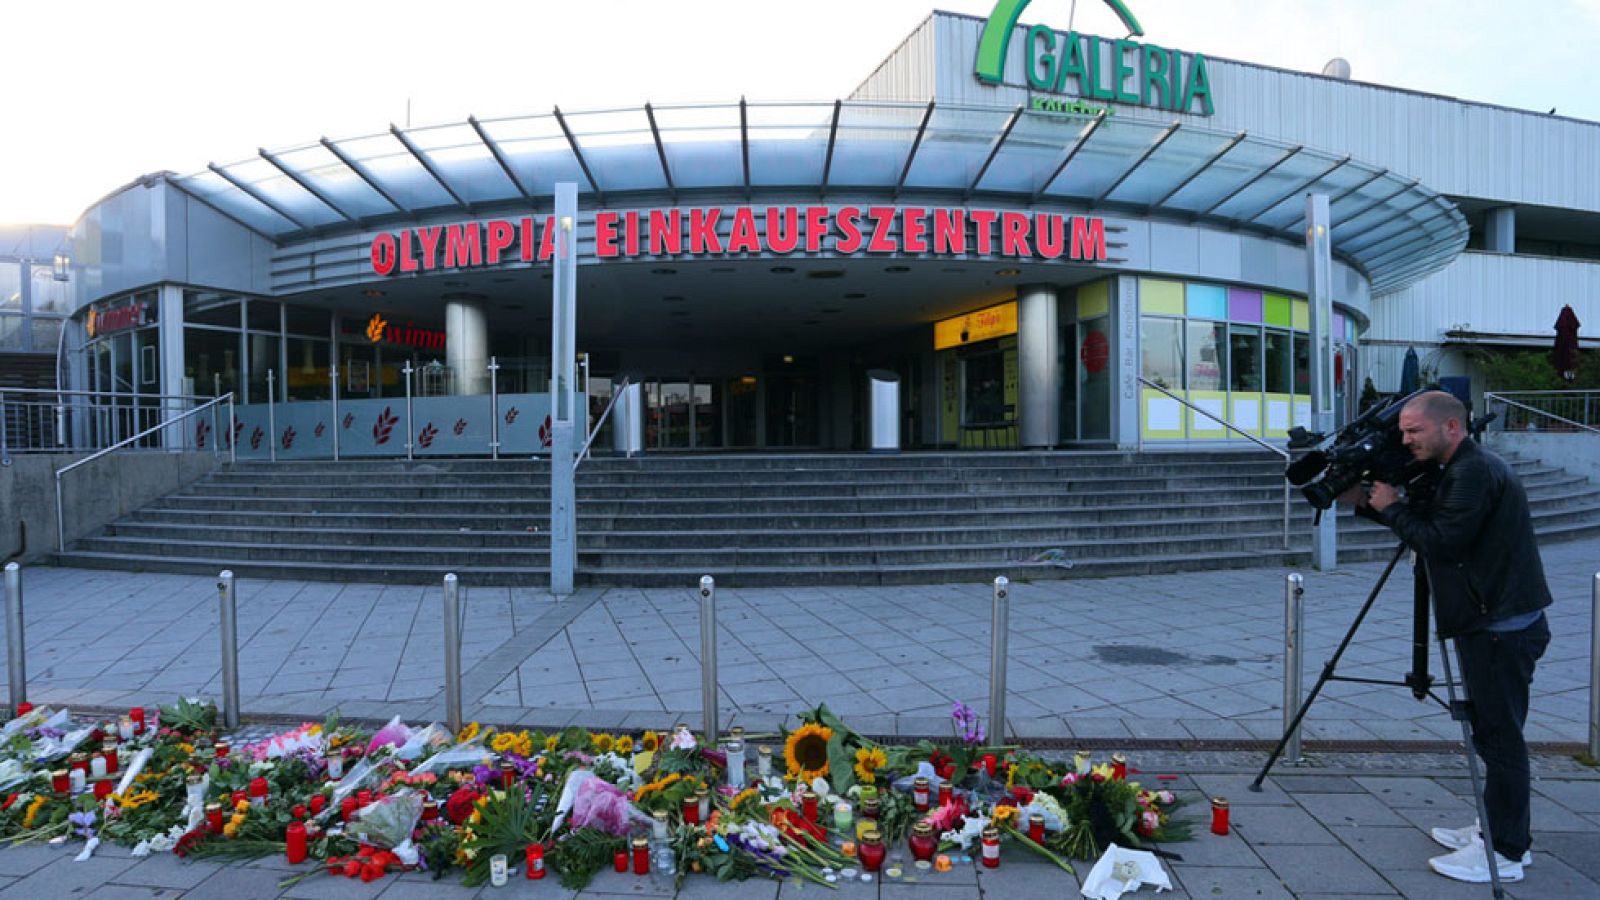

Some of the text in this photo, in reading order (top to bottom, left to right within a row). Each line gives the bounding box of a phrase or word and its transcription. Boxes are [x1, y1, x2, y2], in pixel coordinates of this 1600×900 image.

[1027, 24, 1214, 115] GALERIA
[371, 206, 1107, 276] OLYMPIA EINKAUFSZENTRUM
[386, 320, 448, 348] wimm
